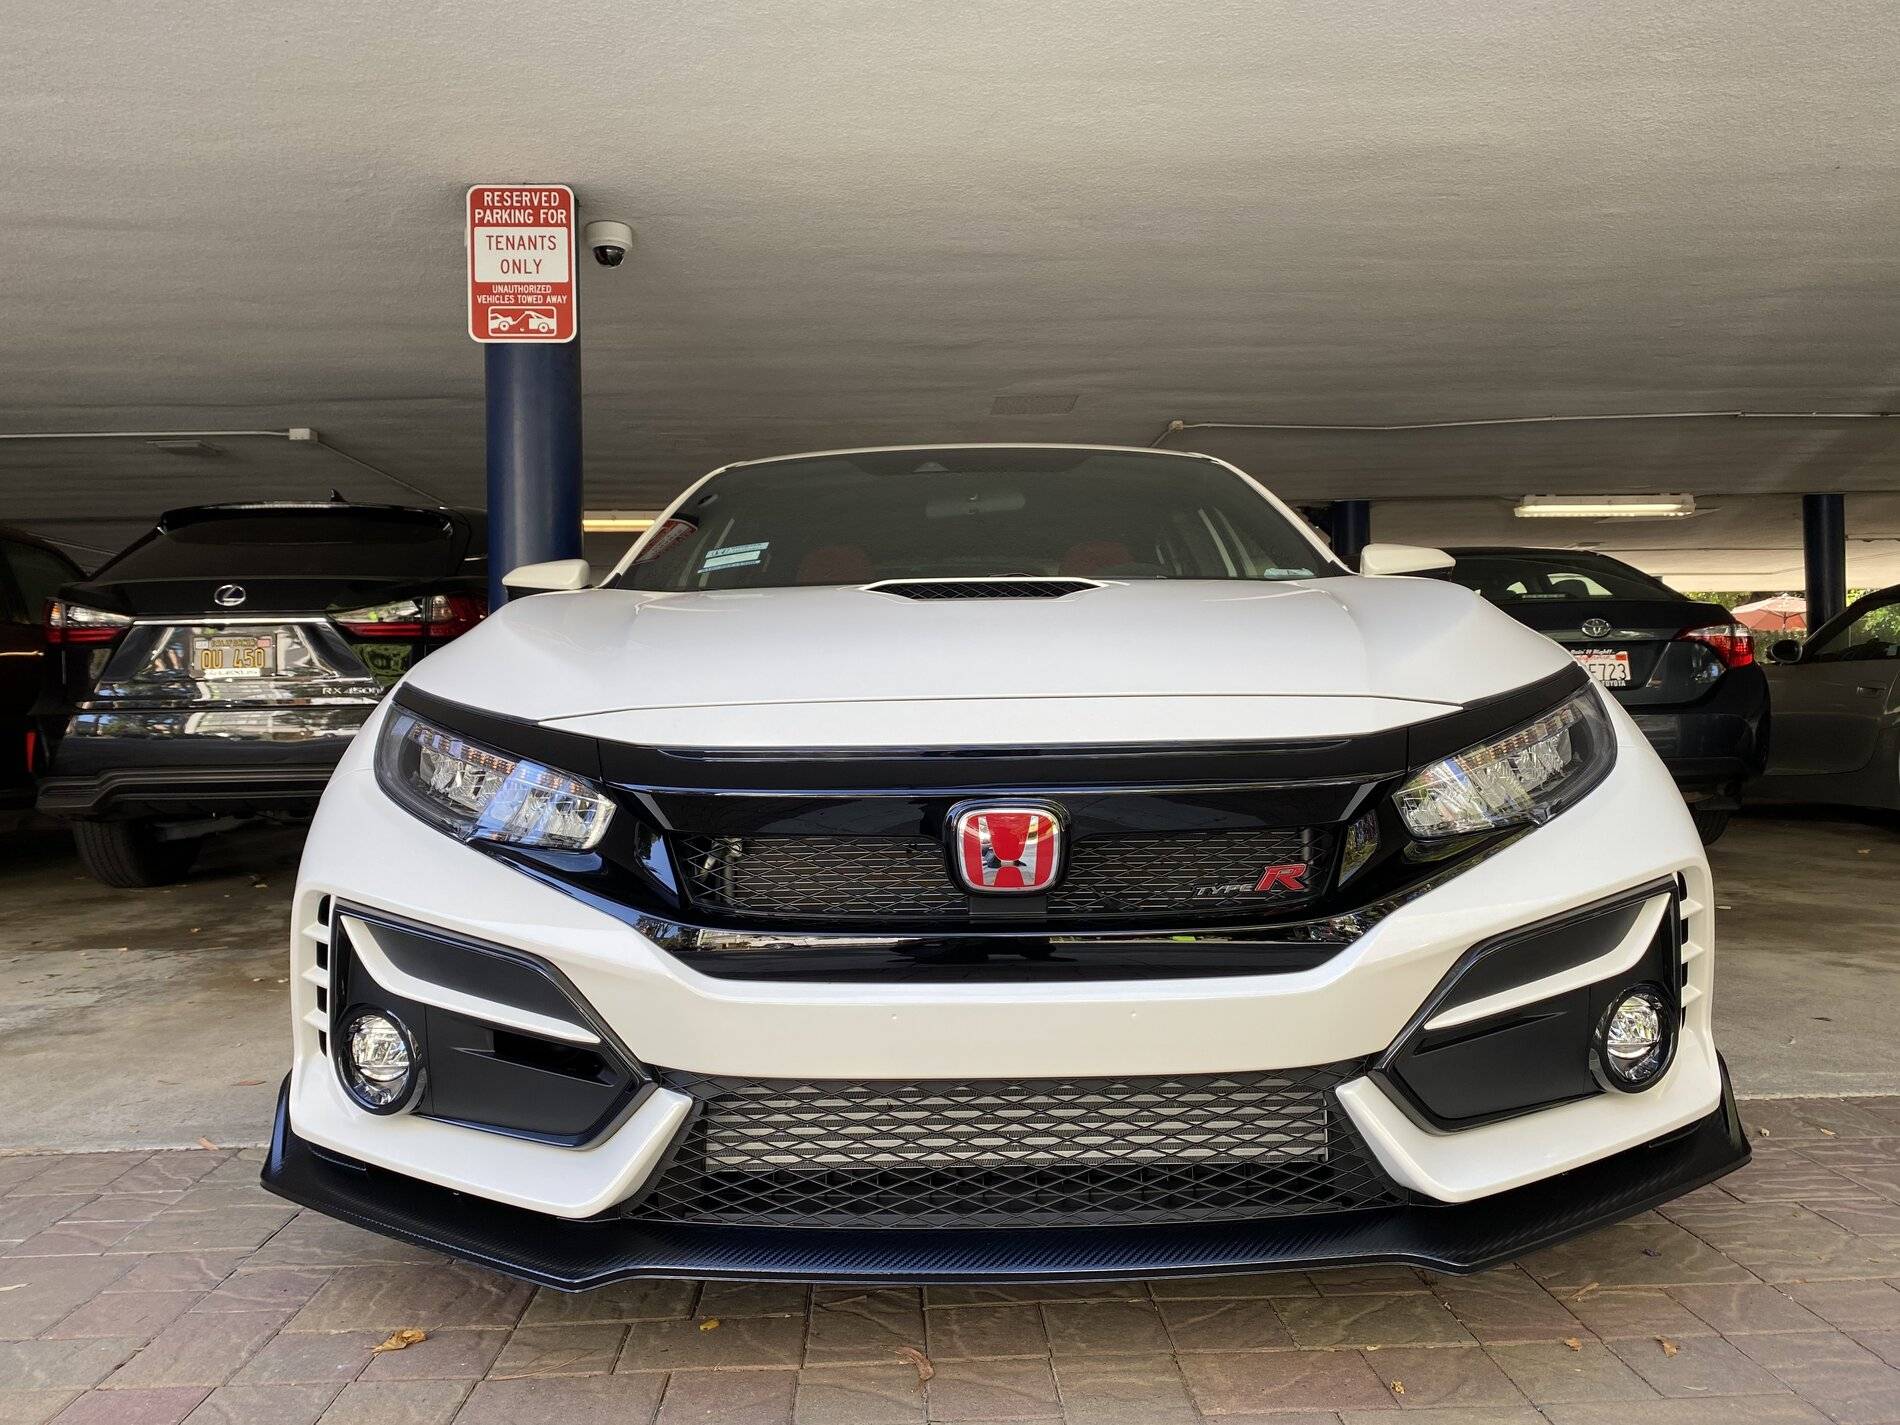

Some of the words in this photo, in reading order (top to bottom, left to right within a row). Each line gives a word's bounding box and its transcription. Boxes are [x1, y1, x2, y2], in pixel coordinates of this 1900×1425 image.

[483, 191, 560, 207] RESERVED
[474, 209, 534, 224] PARKING
[539, 209, 567, 224] FOR
[485, 235, 557, 251] TENANTS
[500, 259, 542, 274] ONLY
[492, 284, 552, 293] UNAUTHORIZED
[477, 295, 515, 304] VEHICLES
[517, 294, 543, 304] TOWED
[546, 294, 567, 304] AWAY
[233, 647, 266, 669] 450
[322, 687, 342, 695] RX
[1195, 883, 1255, 896] TYPE
[1254, 863, 1307, 892] R
